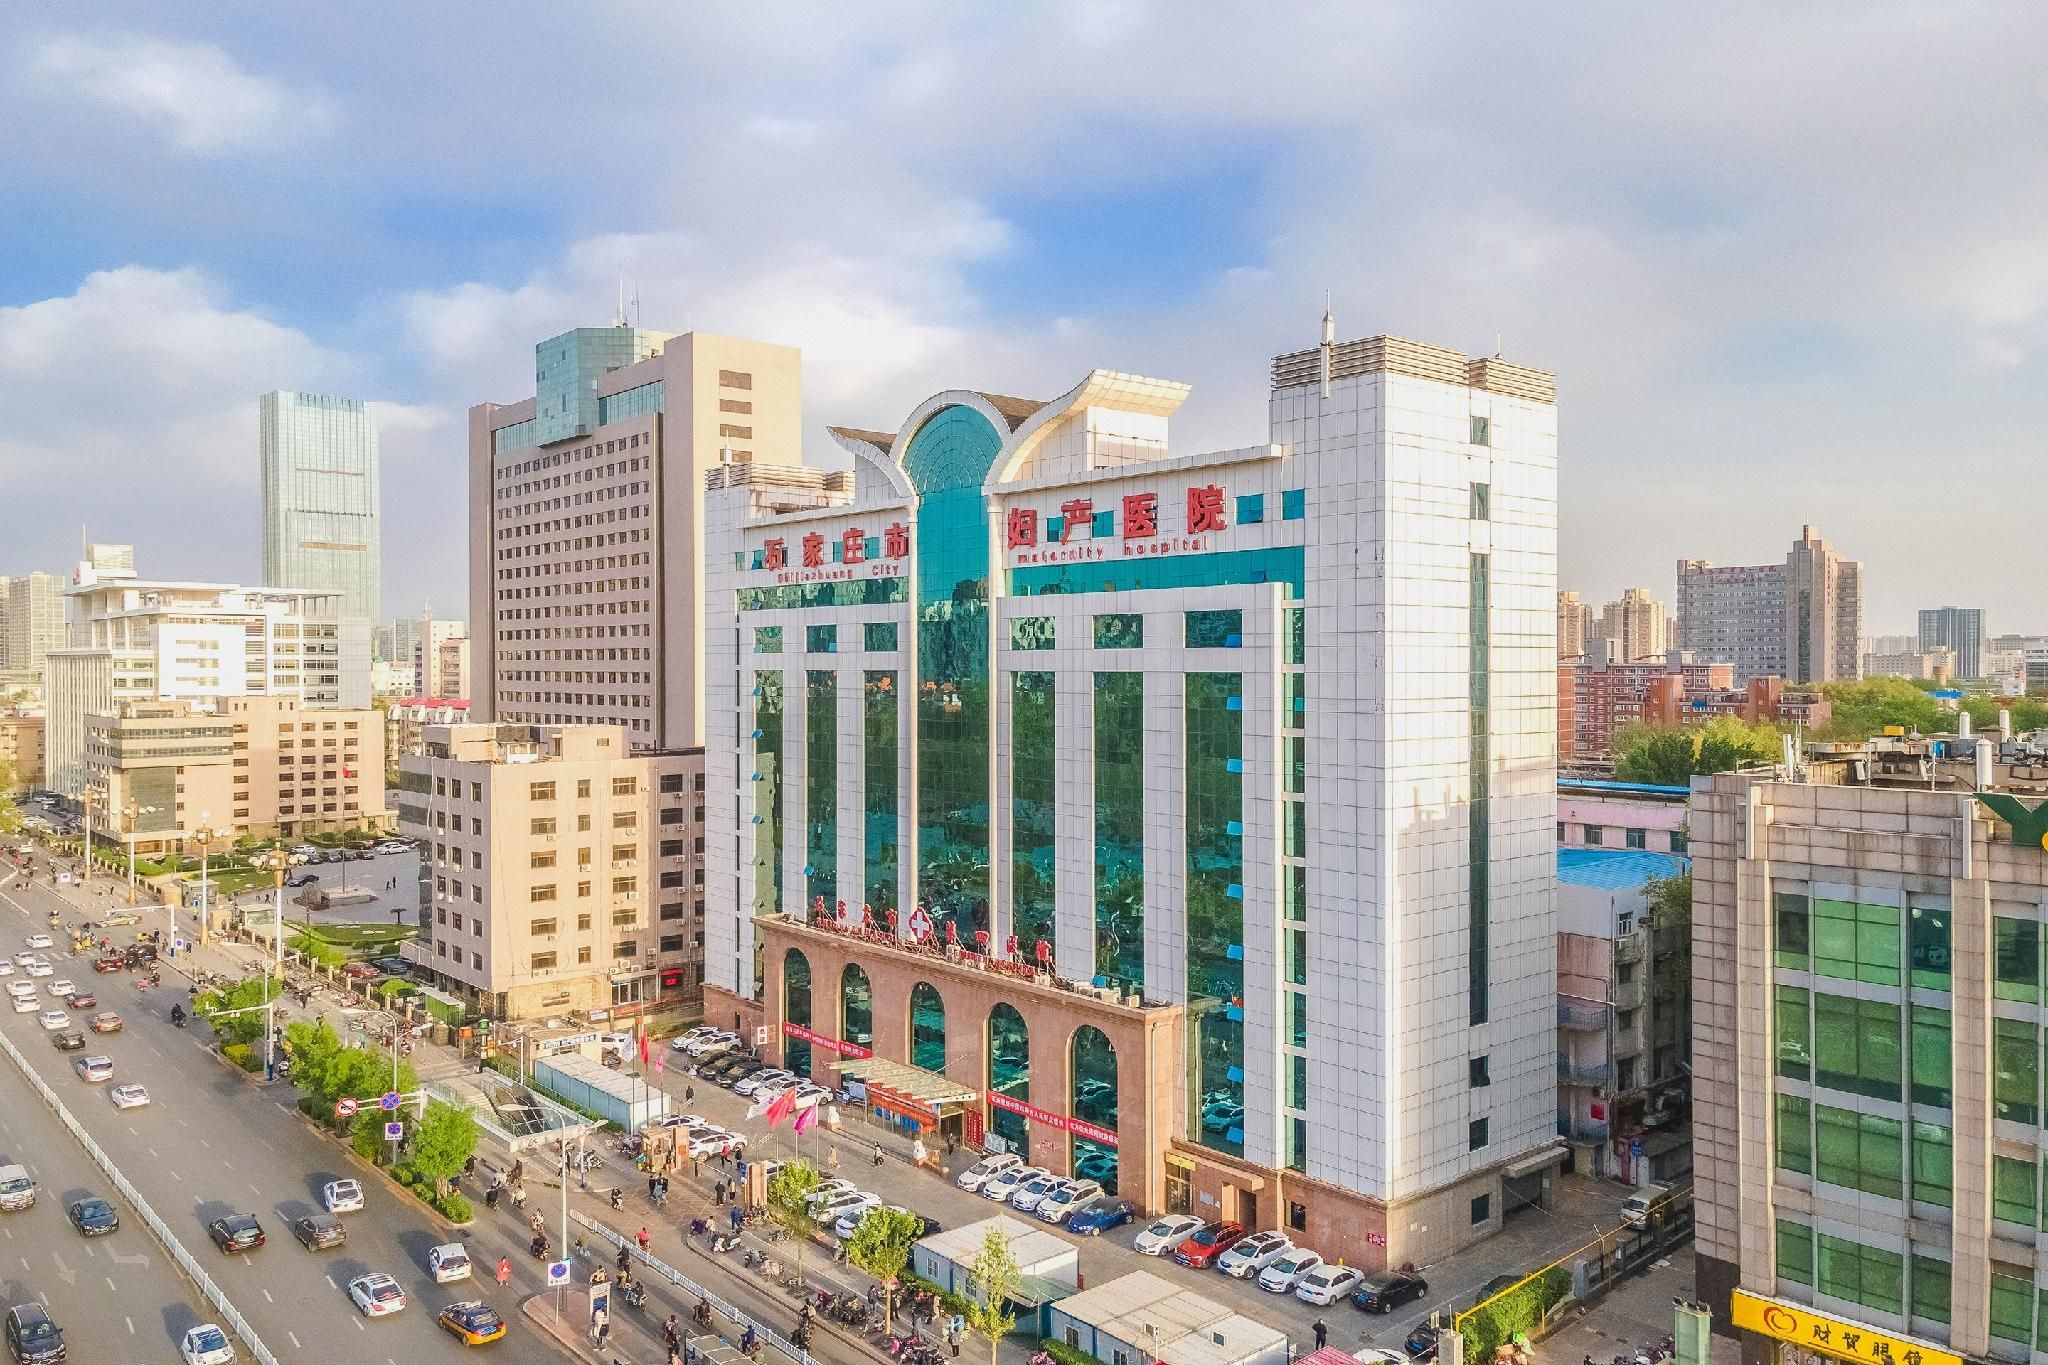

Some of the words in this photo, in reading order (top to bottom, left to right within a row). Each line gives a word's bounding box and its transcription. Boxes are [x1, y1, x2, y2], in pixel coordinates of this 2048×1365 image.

[764, 522, 909, 571] 石家庄市
[1008, 484, 1227, 549] 妇产医院
[872, 563, 899, 576] City
[1018, 545, 1104, 563] maternity
[1124, 535, 1208, 556] hospital
